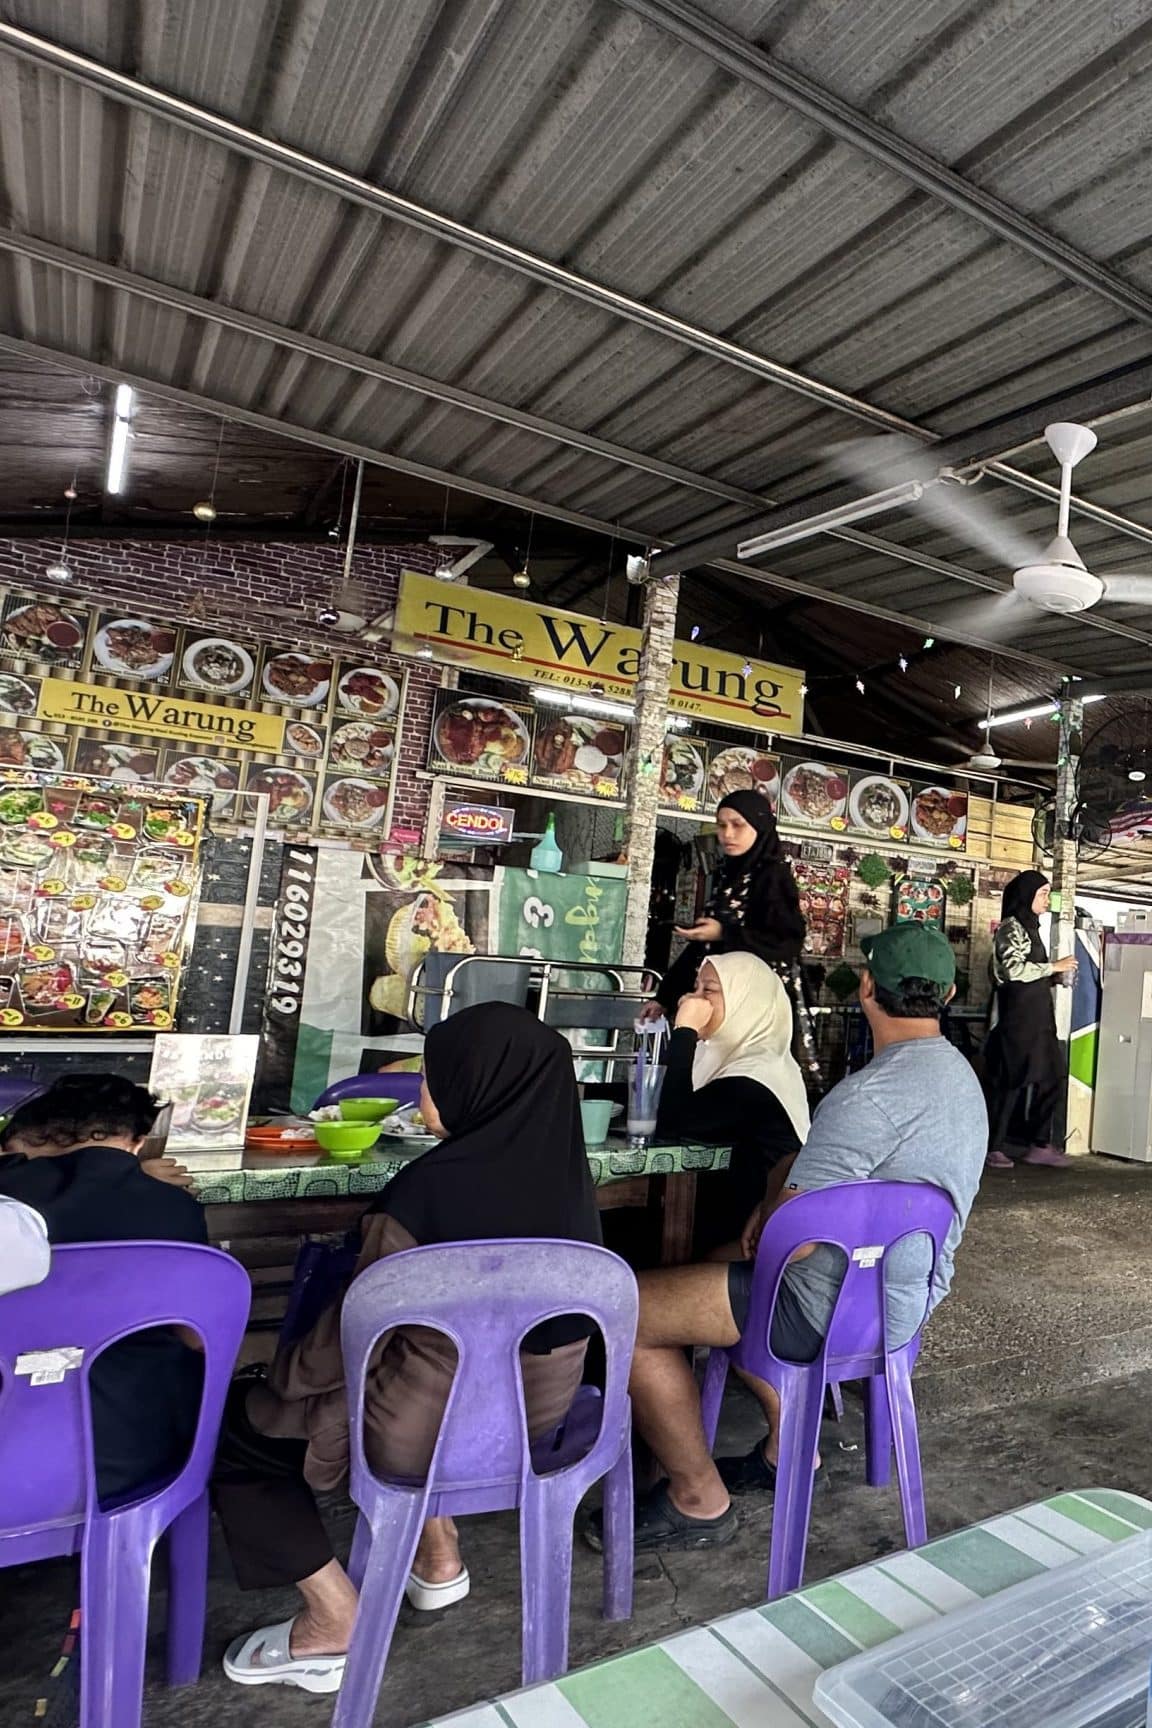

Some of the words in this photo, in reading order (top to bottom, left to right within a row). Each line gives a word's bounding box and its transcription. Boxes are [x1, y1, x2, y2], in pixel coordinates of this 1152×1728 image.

[424, 601, 523, 650] The
[536, 612, 784, 717] Waung
[533, 669, 561, 683] TEL:
[71, 691, 119, 716] The
[125, 693, 257, 741] Warung
[446, 812, 506, 832] CENDOL
